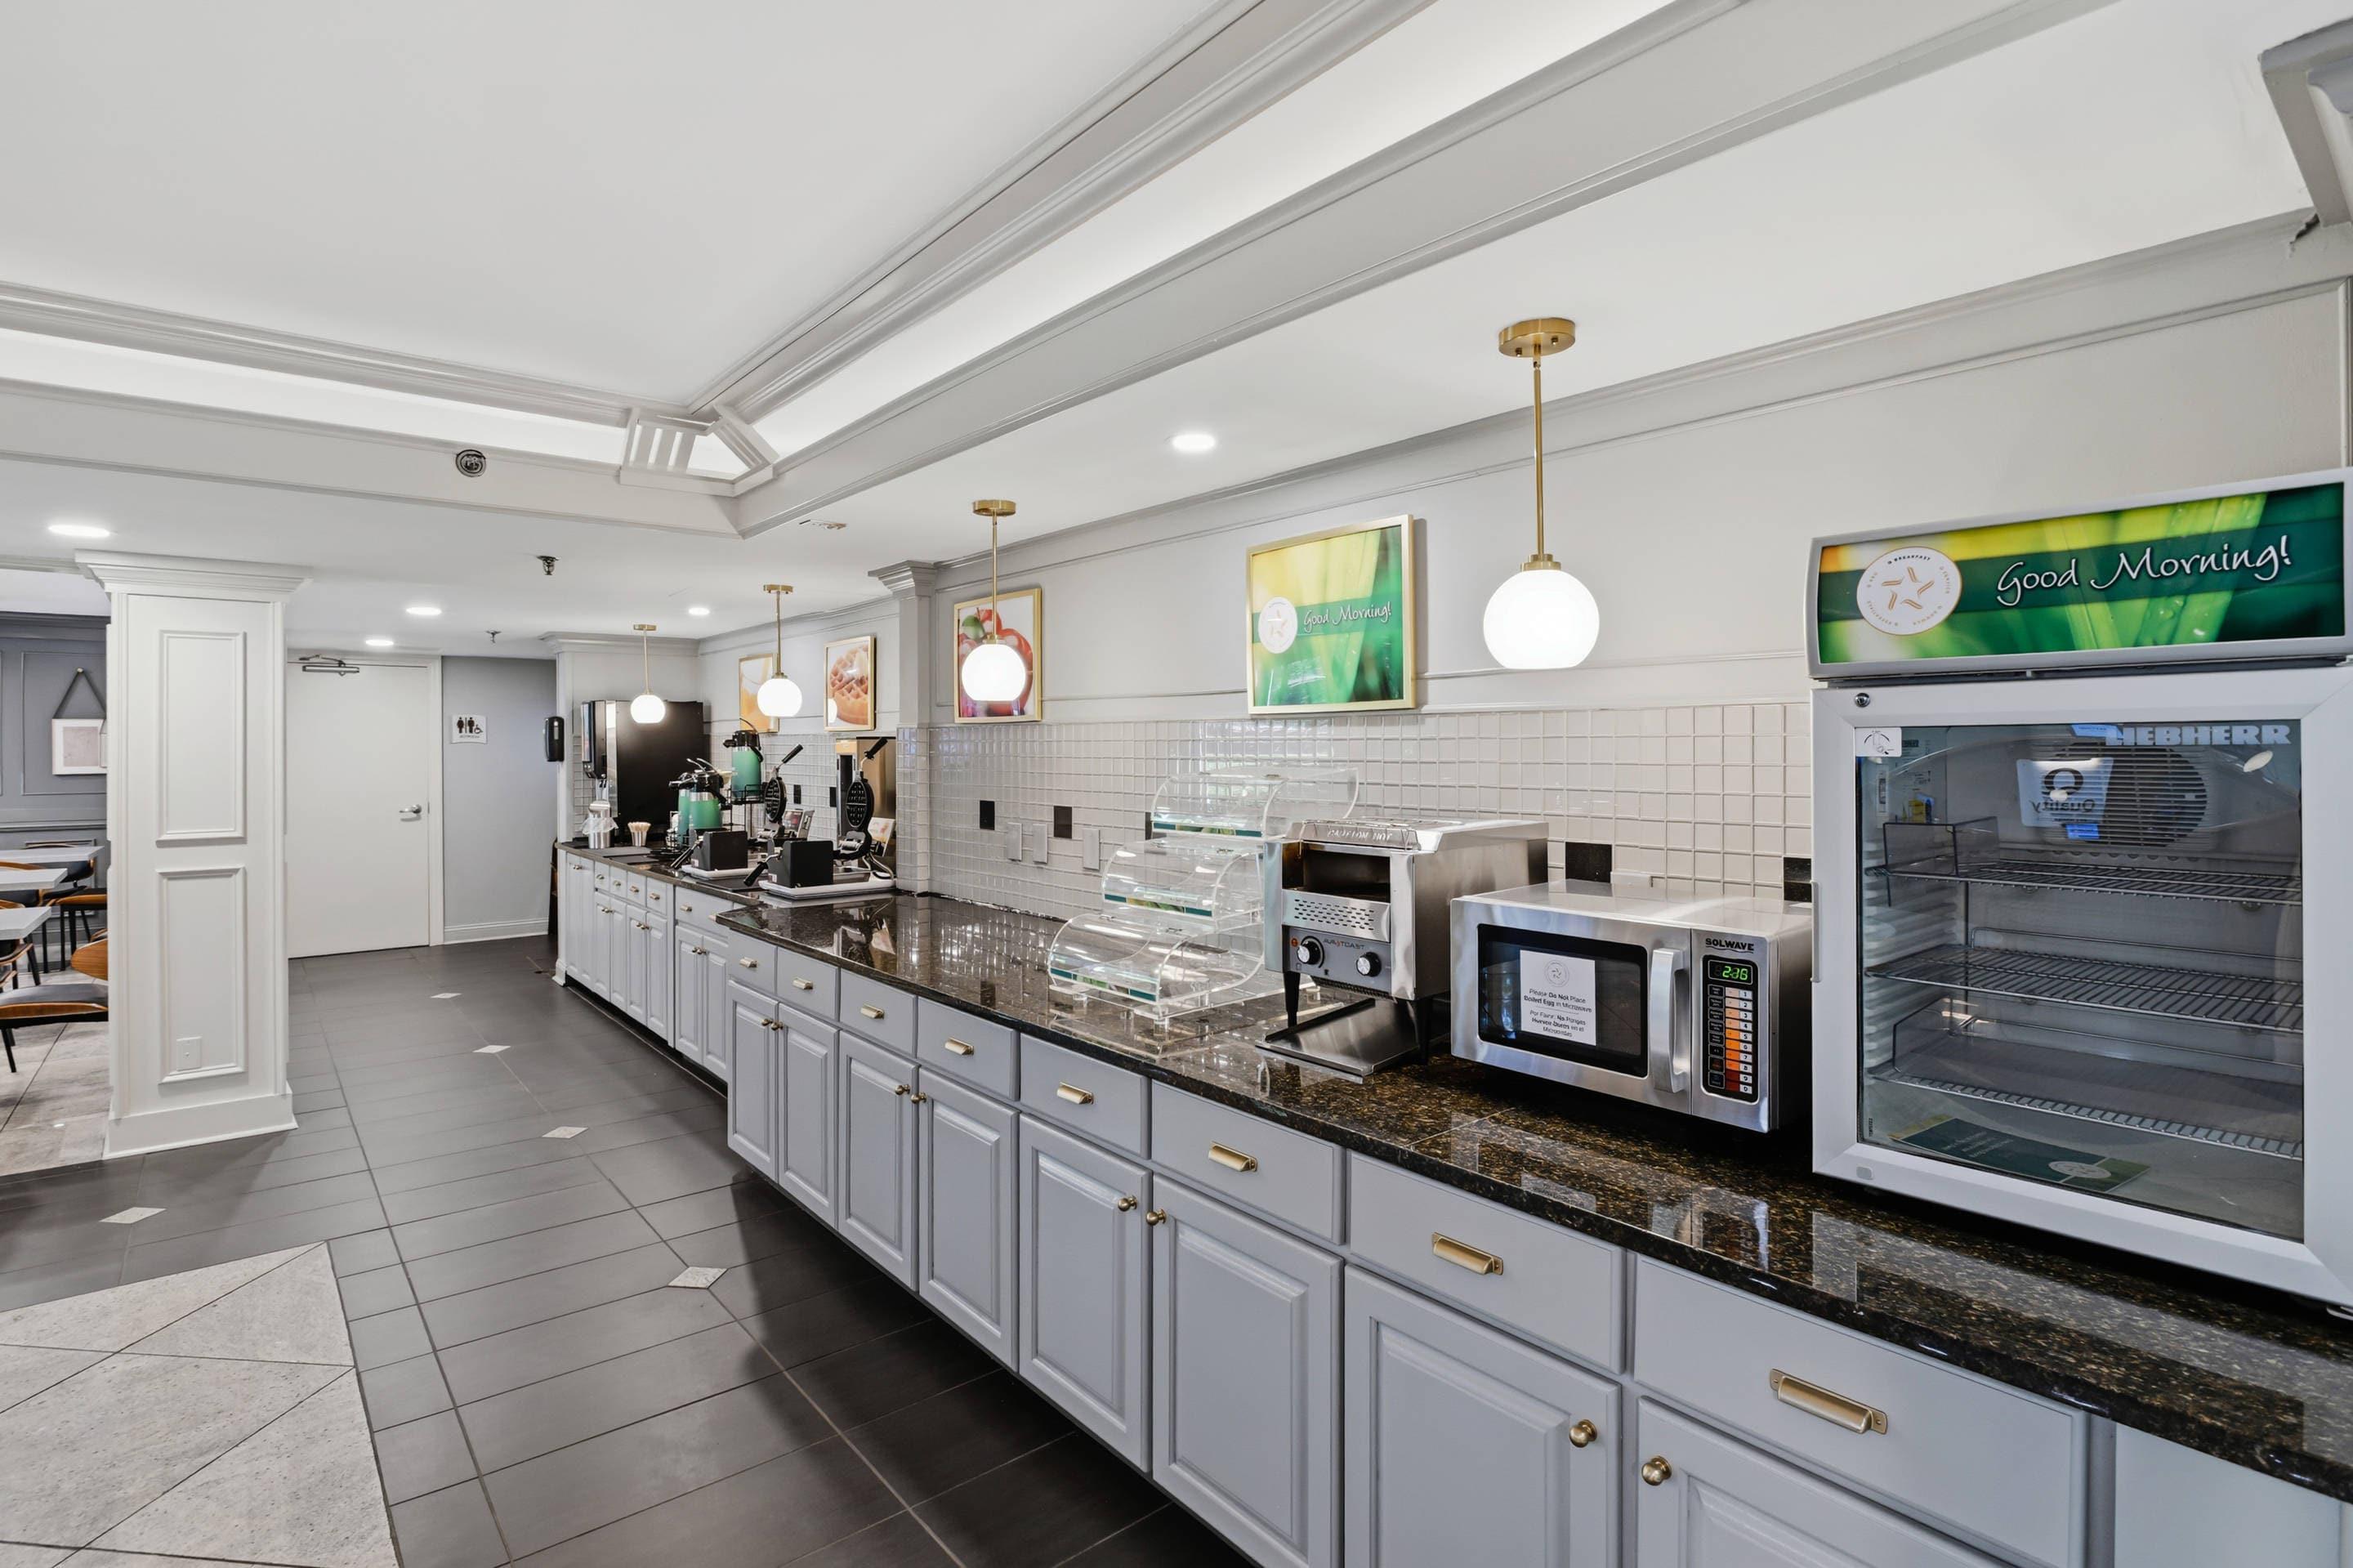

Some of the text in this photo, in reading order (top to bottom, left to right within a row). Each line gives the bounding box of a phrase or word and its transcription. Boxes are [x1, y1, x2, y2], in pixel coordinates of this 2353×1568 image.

[1997, 535, 2292, 606] Good Morning!
[1304, 601, 1392, 633] Good Morning!
[2105, 725, 2291, 745] LIEBHERR
[1706, 938, 1754, 951] SOLWAVE
[1524, 995, 1542, 1003] Boiled
[1543, 998, 1555, 1007] Egg
